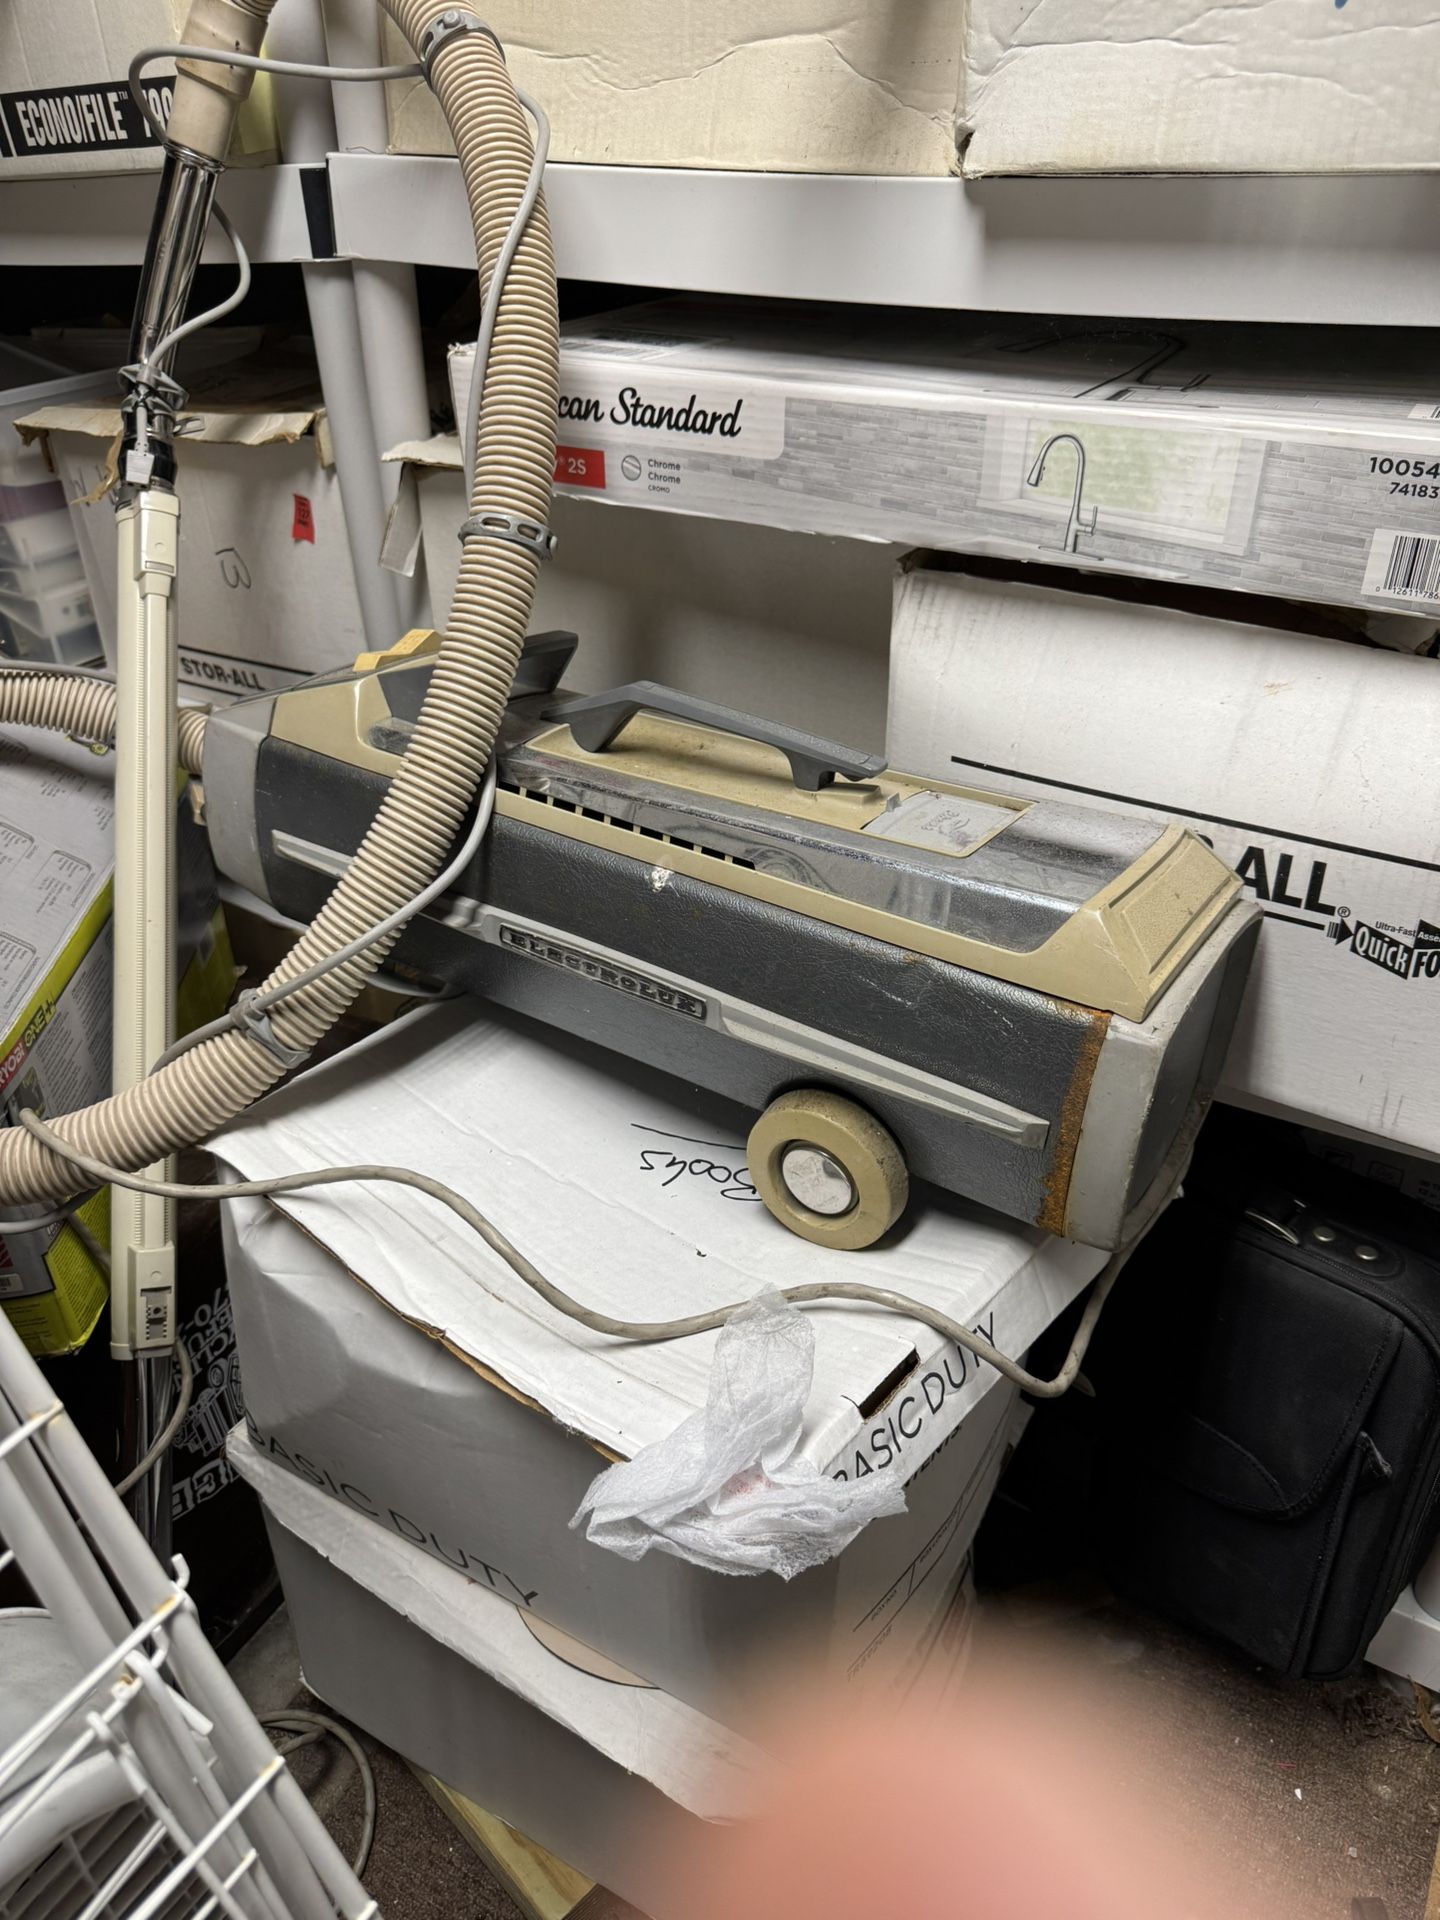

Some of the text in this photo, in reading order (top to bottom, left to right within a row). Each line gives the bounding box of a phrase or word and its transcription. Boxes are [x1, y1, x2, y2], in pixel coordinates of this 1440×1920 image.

[610, 387, 743, 438] Standard
[568, 457, 587, 475] 2S
[647, 459, 681, 471] Chrome
[1370, 456, 1440, 479] 10054
[647, 472, 681, 485] Chrome
[1389, 481, 1440, 499] 74183
[180, 656, 266, 691] STOR-ALL
[1375, 921, 1417, 937] Ultra-Fast
[506, 927, 699, 1015] ELECTROLUX
[388, 1508, 539, 1607] DUTY
